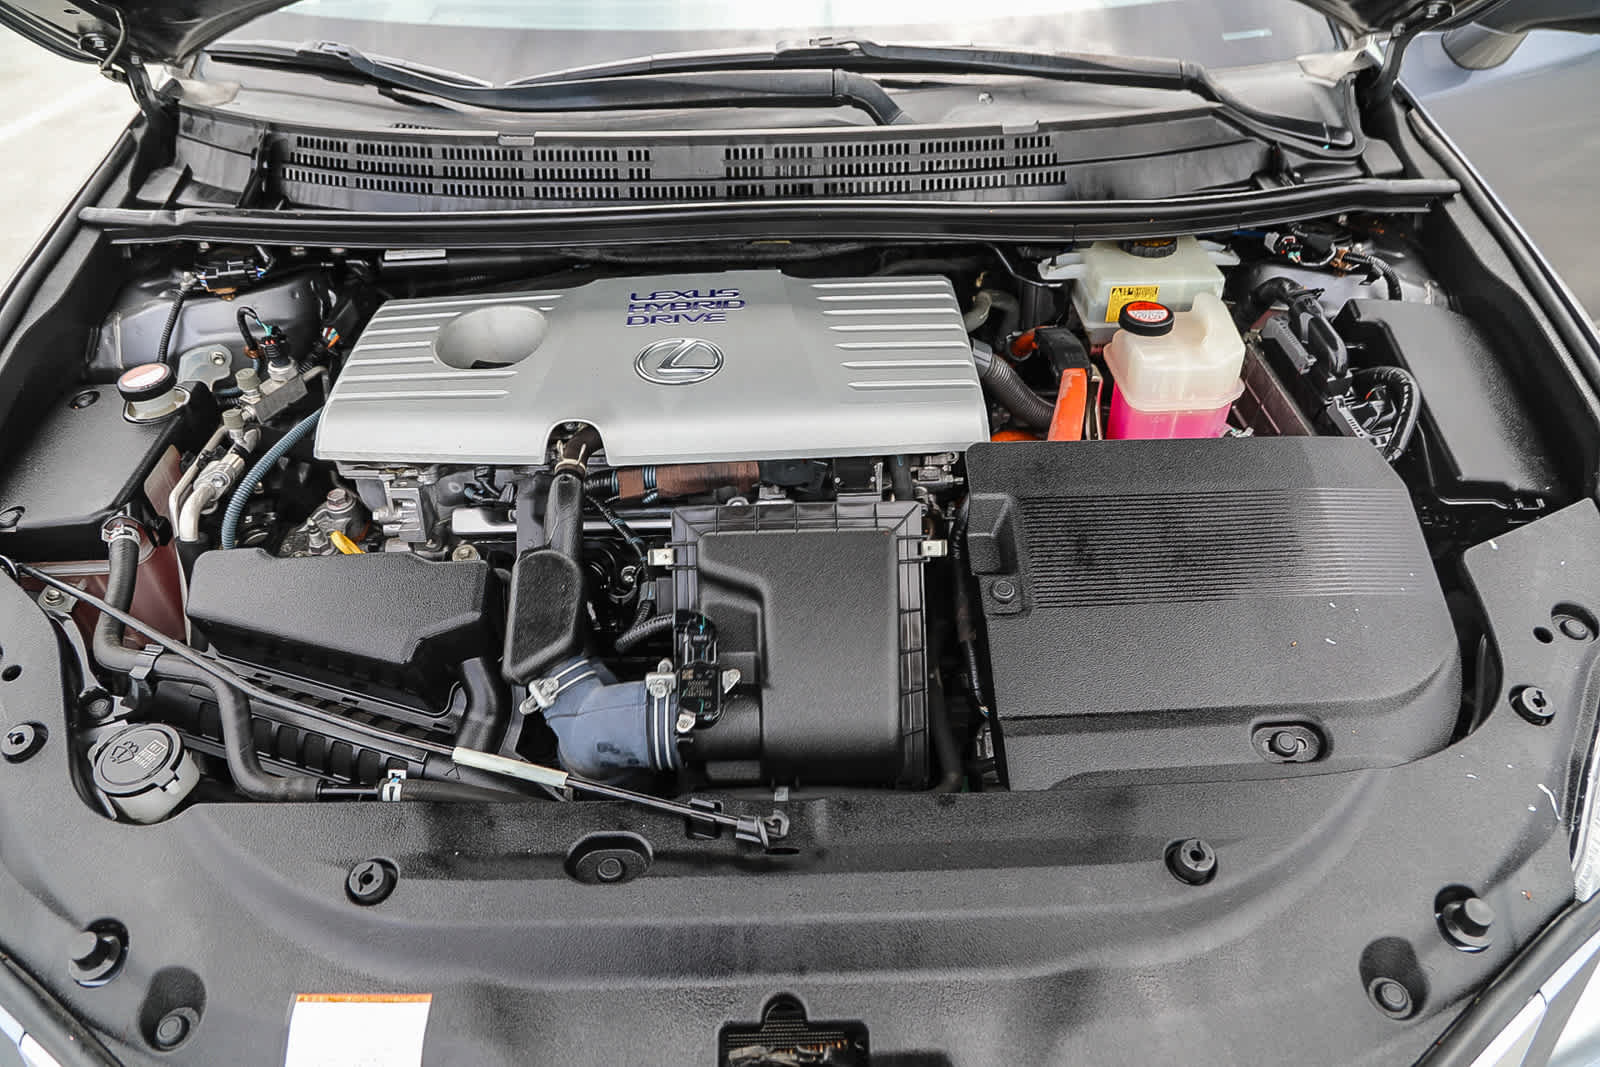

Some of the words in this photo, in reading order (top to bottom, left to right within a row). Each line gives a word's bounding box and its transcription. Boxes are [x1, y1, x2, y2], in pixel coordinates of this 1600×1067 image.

[630, 288, 740, 301] LEXUS
[628, 300, 745, 313] HYBRID
[626, 312, 727, 326] DRIVE
